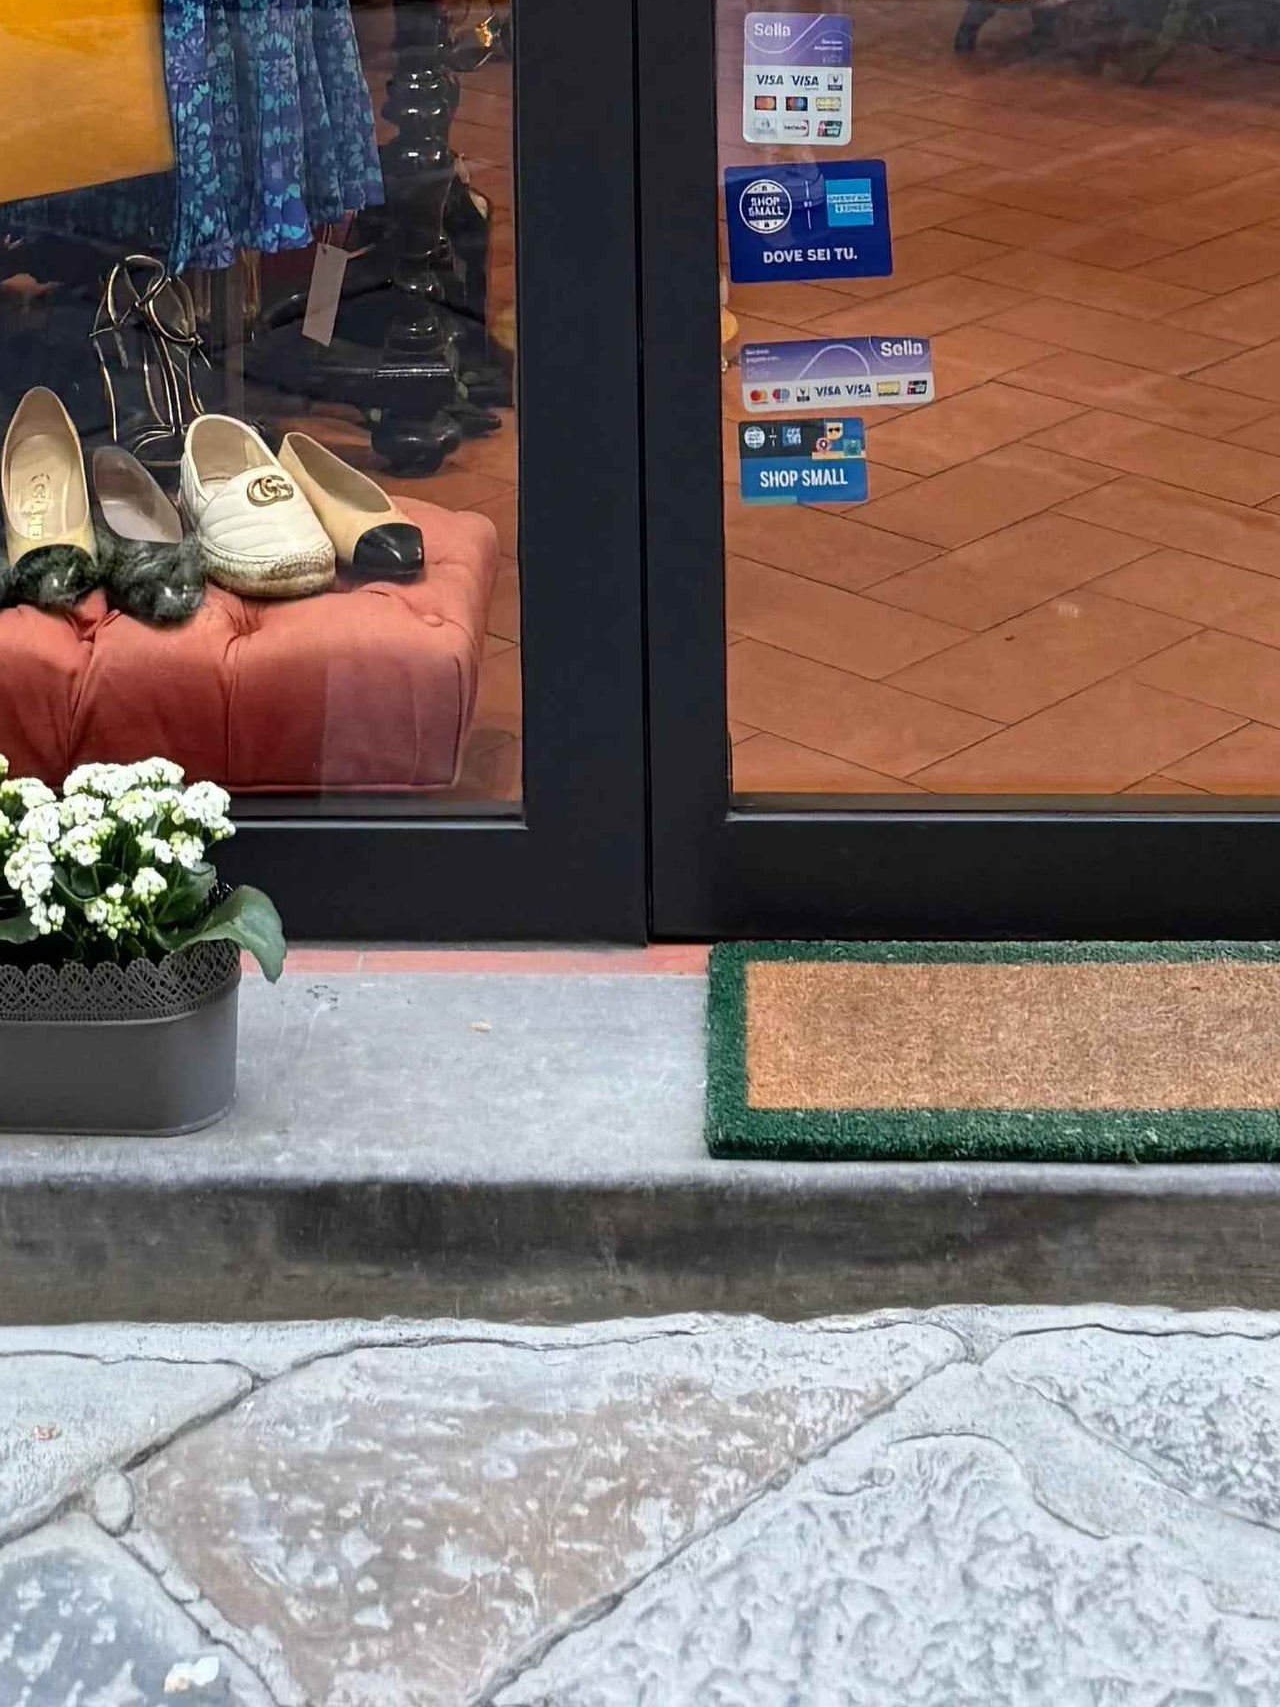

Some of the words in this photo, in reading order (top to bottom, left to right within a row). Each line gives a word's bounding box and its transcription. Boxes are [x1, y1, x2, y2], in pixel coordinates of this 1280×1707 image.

[756, 74, 785, 86] VISA
[792, 74, 820, 87] VISA
[751, 196, 780, 207] SHOP
[748, 206, 785, 217] SMALL
[763, 249, 804, 264] DOVE
[807, 248, 831, 262] SEI
[834, 247, 858, 261] TU.
[815, 385, 842, 398] VISA
[845, 384, 871, 396] VISA
[760, 470, 799, 488] SHOP
[801, 468, 849, 487] SMALL
